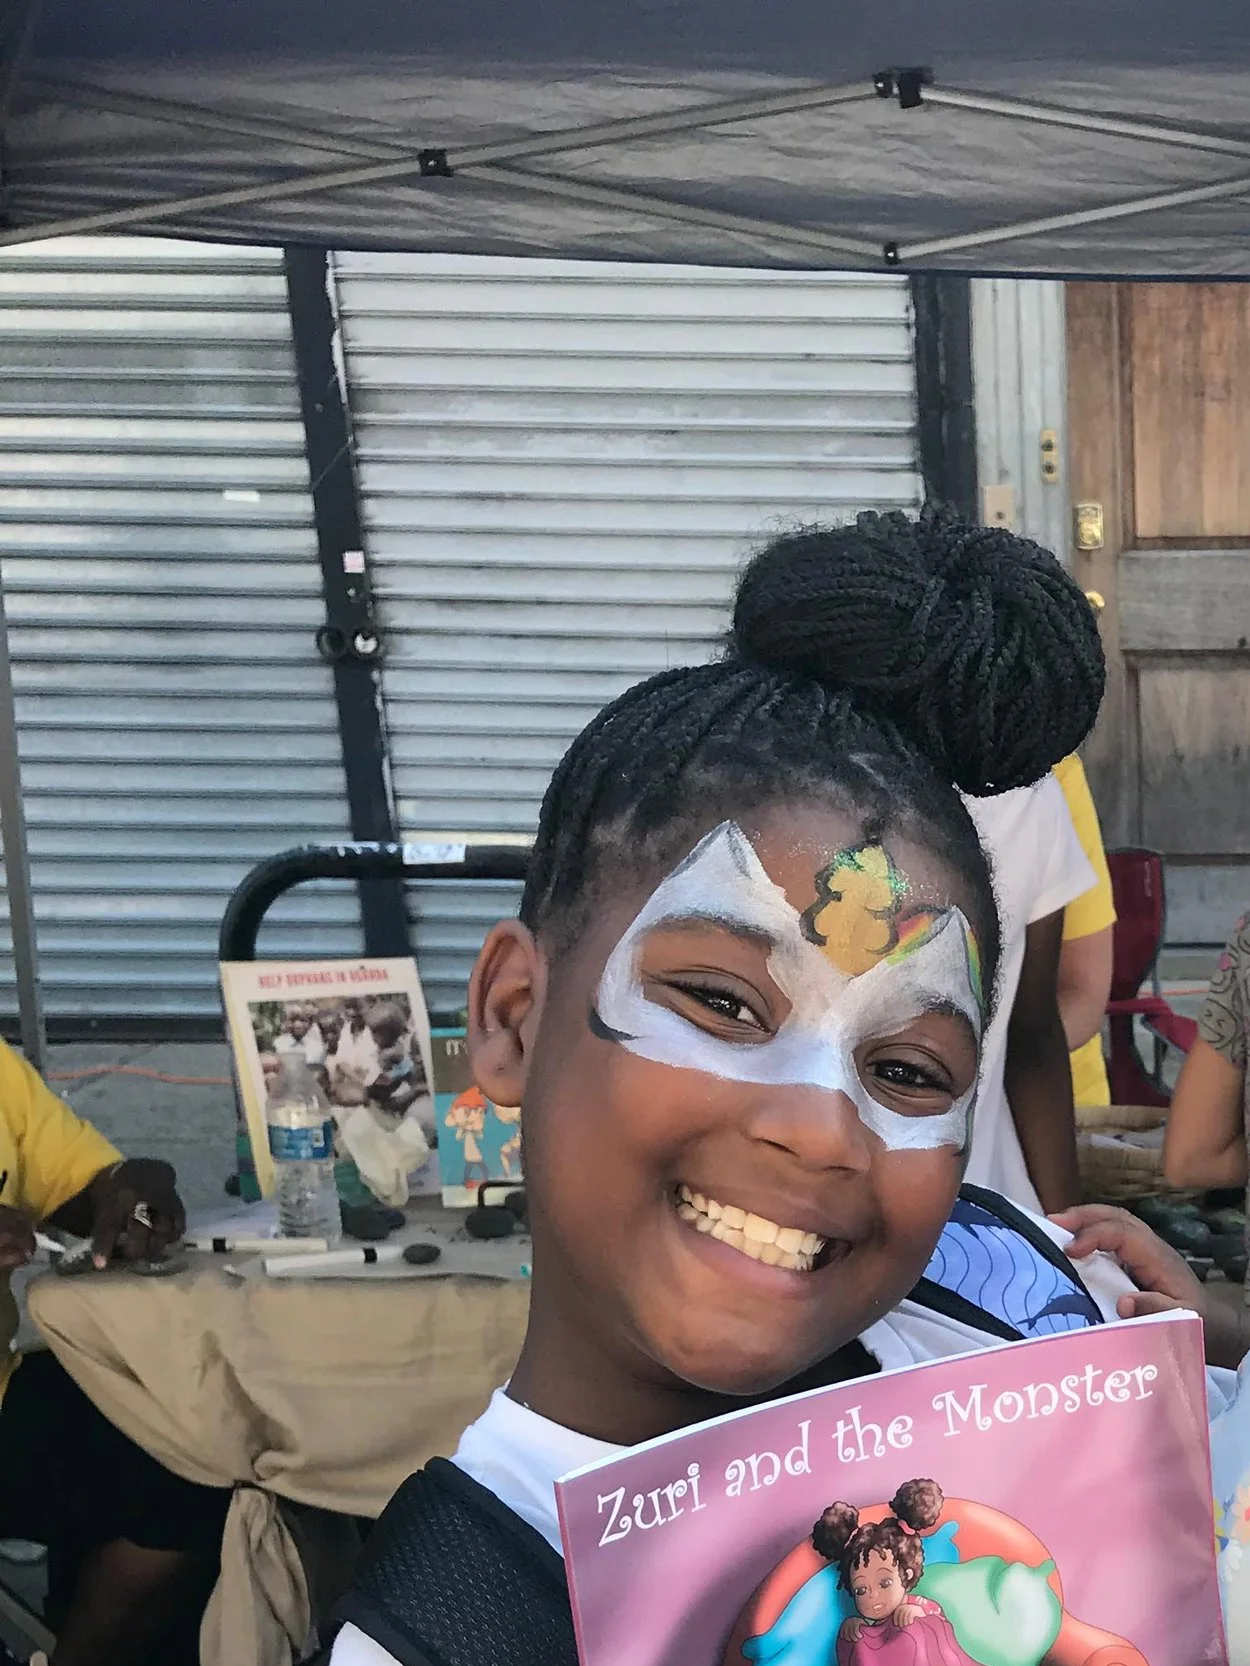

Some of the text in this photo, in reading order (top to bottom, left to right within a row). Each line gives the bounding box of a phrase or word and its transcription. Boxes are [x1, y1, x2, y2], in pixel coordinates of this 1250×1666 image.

[596, 1362, 1159, 1548] Zuri and the Monster
